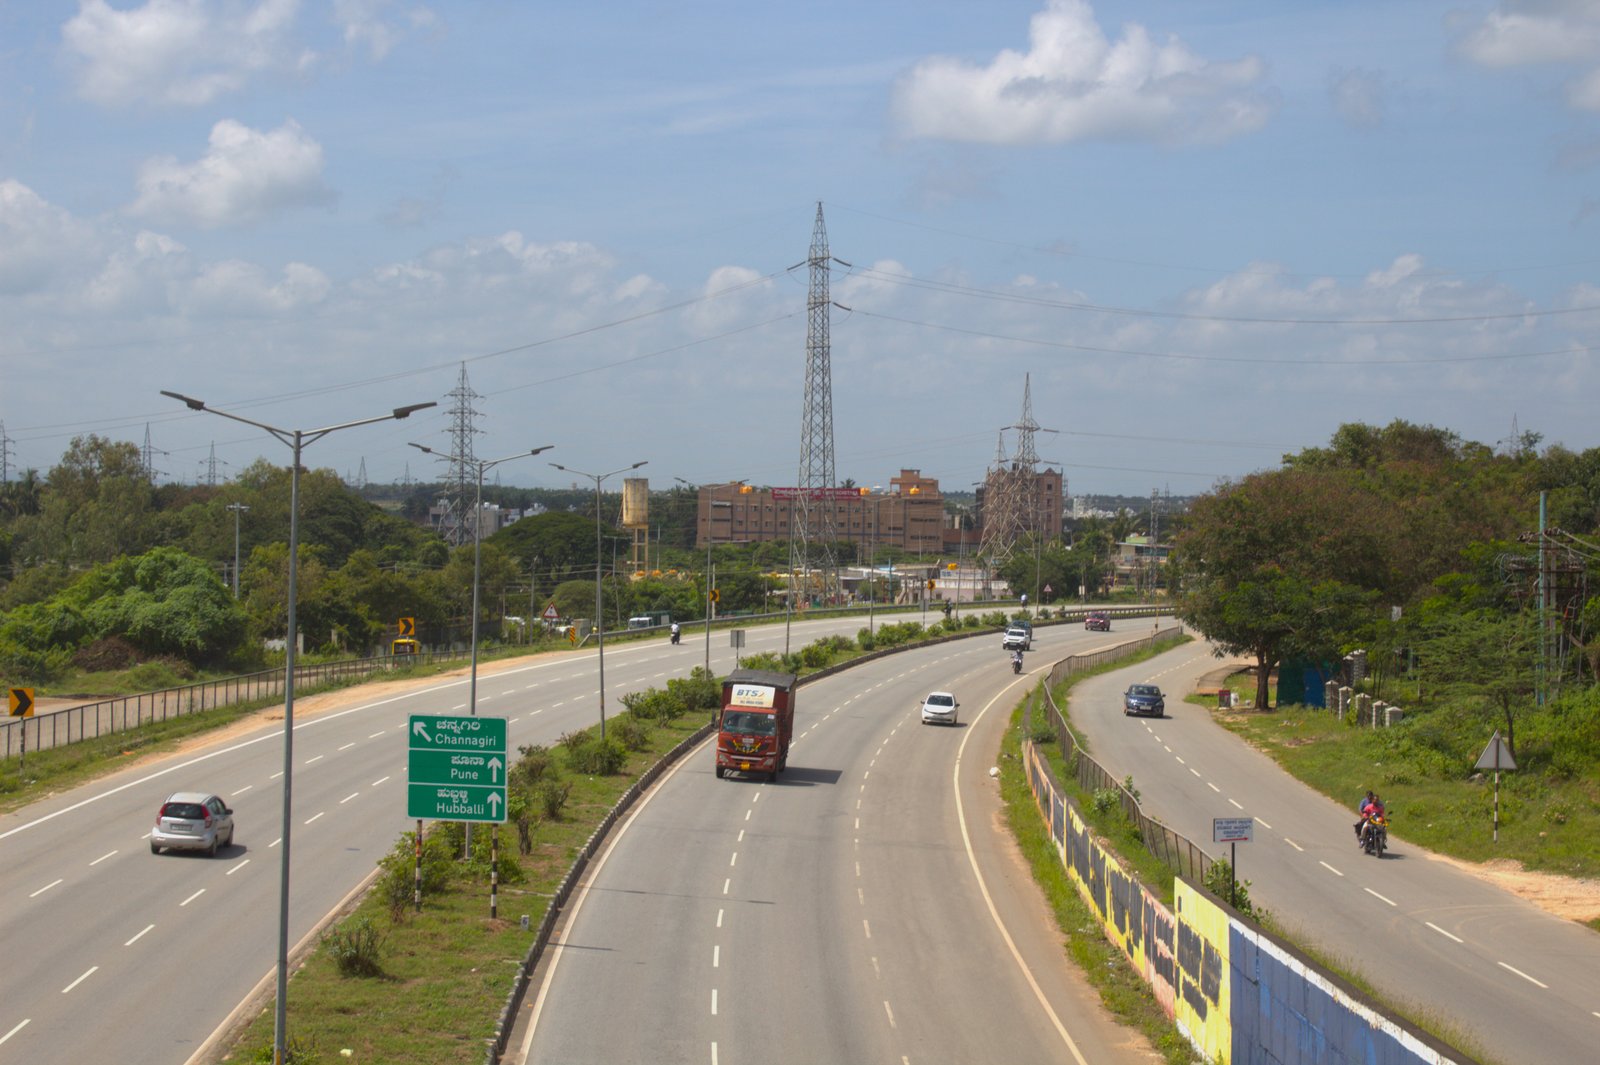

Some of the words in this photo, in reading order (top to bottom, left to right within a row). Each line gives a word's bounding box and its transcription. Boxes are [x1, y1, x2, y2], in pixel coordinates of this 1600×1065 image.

[736, 688, 759, 697] BTS
[435, 733, 496, 748] Channagiri
[450, 768, 479, 780] Pune
[436, 802, 484, 815] Hubballi
